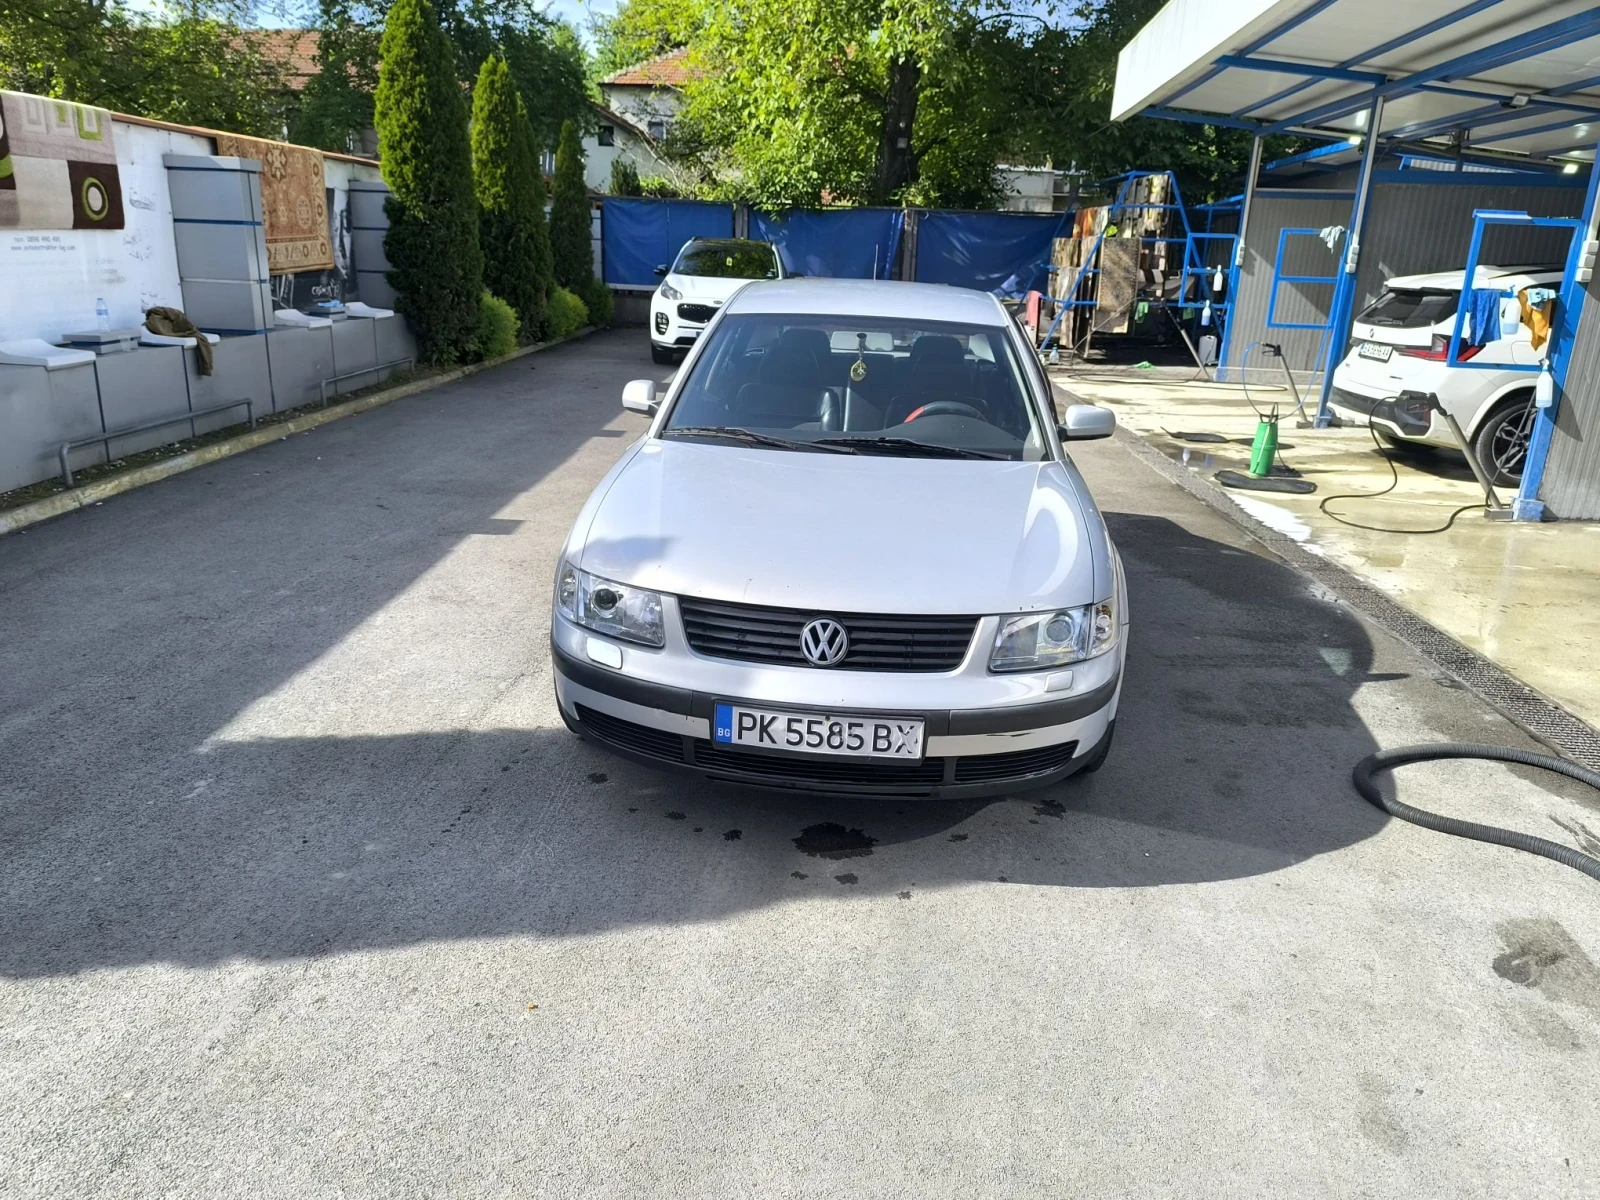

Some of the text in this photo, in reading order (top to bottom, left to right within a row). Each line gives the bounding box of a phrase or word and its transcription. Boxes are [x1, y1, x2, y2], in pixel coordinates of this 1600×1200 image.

[801, 619, 848, 665] VW
[717, 727, 731, 737] BG
[737, 711, 915, 754] PK 5585 BX
